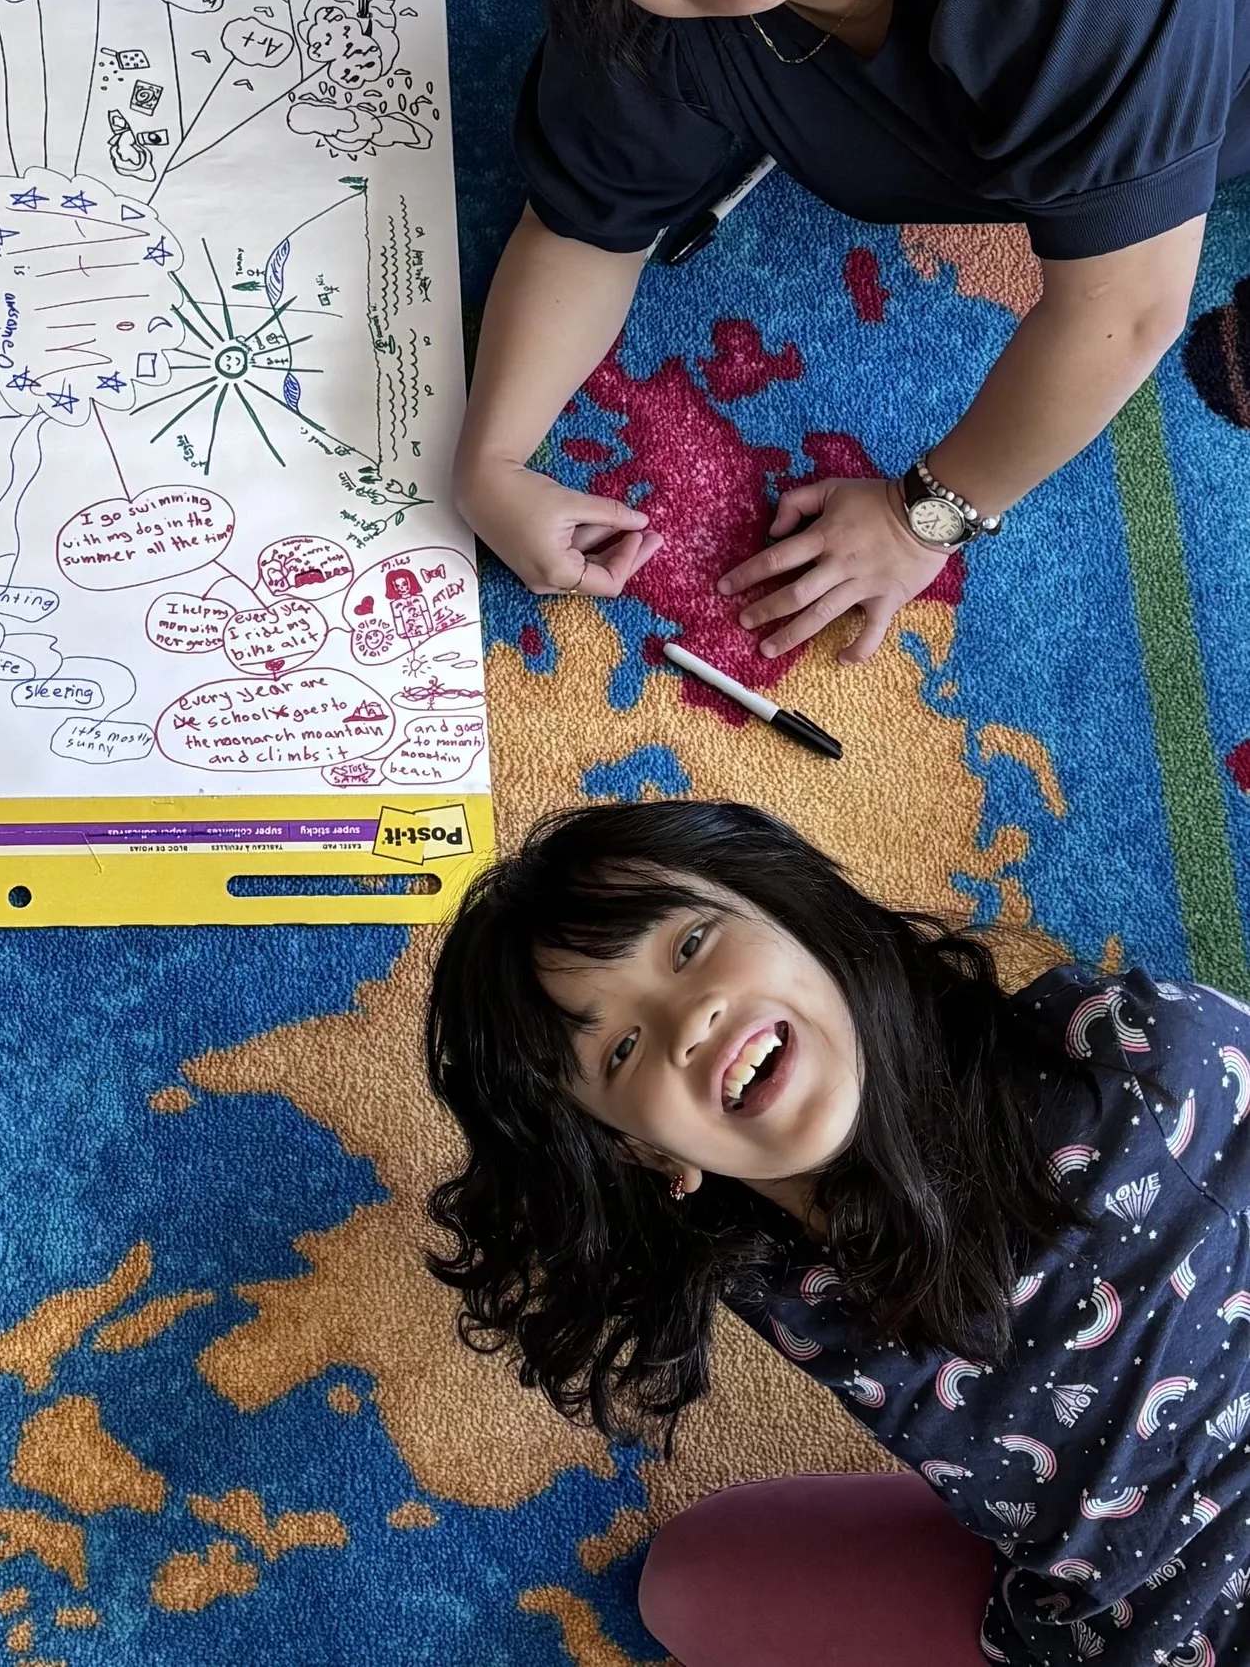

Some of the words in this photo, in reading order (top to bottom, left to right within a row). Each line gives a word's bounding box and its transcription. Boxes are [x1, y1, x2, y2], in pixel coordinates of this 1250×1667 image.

[81, 513, 94, 526] I
[101, 512, 121, 527] go
[128, 492, 213, 518] swimming
[136, 522, 164, 536] dog
[187, 511, 213, 528] the
[63, 550, 136, 566] summer
[147, 541, 166, 554] all
[171, 536, 199, 552] the
[166, 603, 179, 614] I
[183, 604, 210, 619] help
[159, 620, 187, 632] mom
[245, 626, 284, 640] ride
[178, 690, 233, 711] every
[245, 681, 293, 703] year
[414, 719, 449, 733] and
[414, 735, 430, 747] to
[209, 750, 249, 763] and
[256, 748, 319, 762] climbs
[256, 826, 282, 835] super
[300, 825, 330, 838] sticky
[332, 826, 360, 837] super
[1105, 1172, 1162, 1209] LOVE
[1058, 1383, 1099, 1429] LOVE
[984, 1499, 1038, 1515] LOVE
